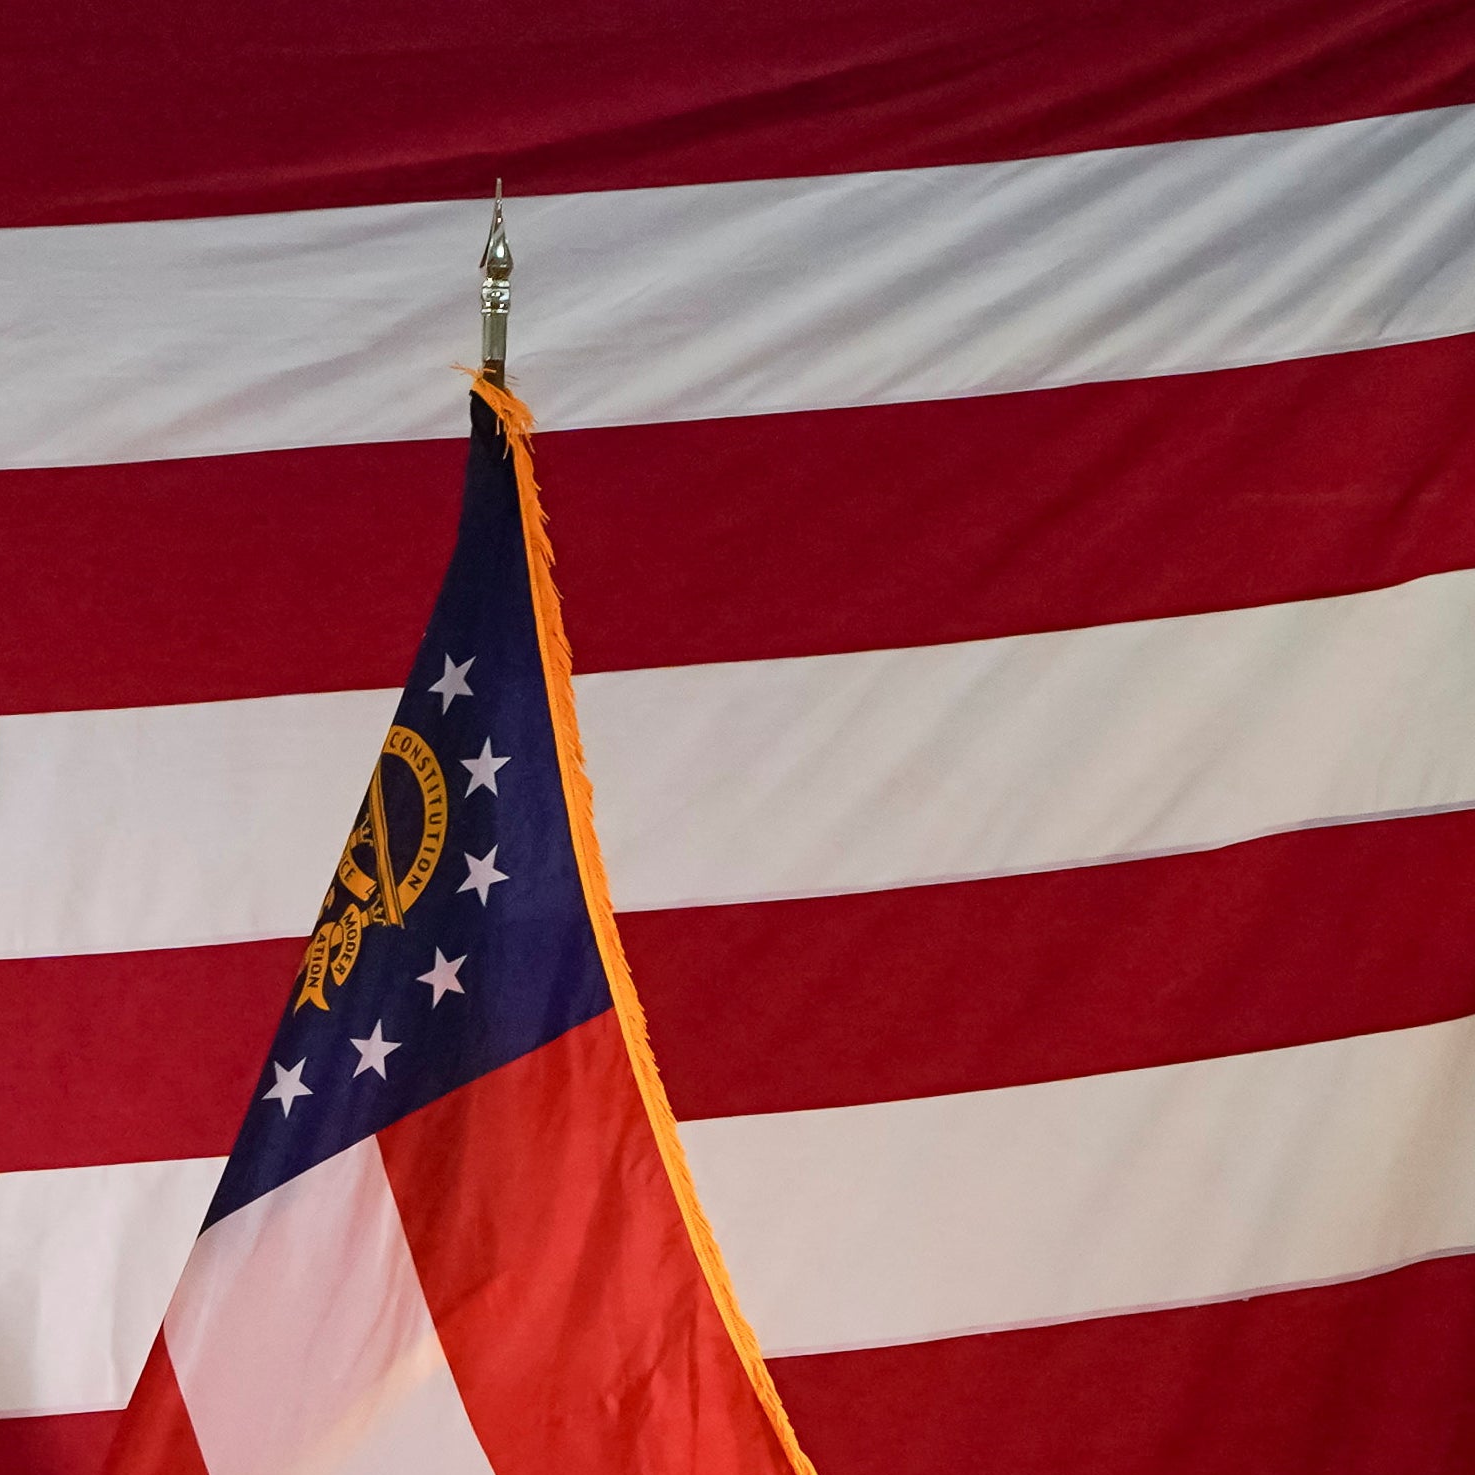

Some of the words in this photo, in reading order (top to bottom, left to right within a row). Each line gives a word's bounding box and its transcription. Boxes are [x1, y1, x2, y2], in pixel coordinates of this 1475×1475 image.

[388, 731, 444, 891] CONSTITUTION
[307, 932, 327, 989] ATION
[333, 911, 358, 976] MODER
